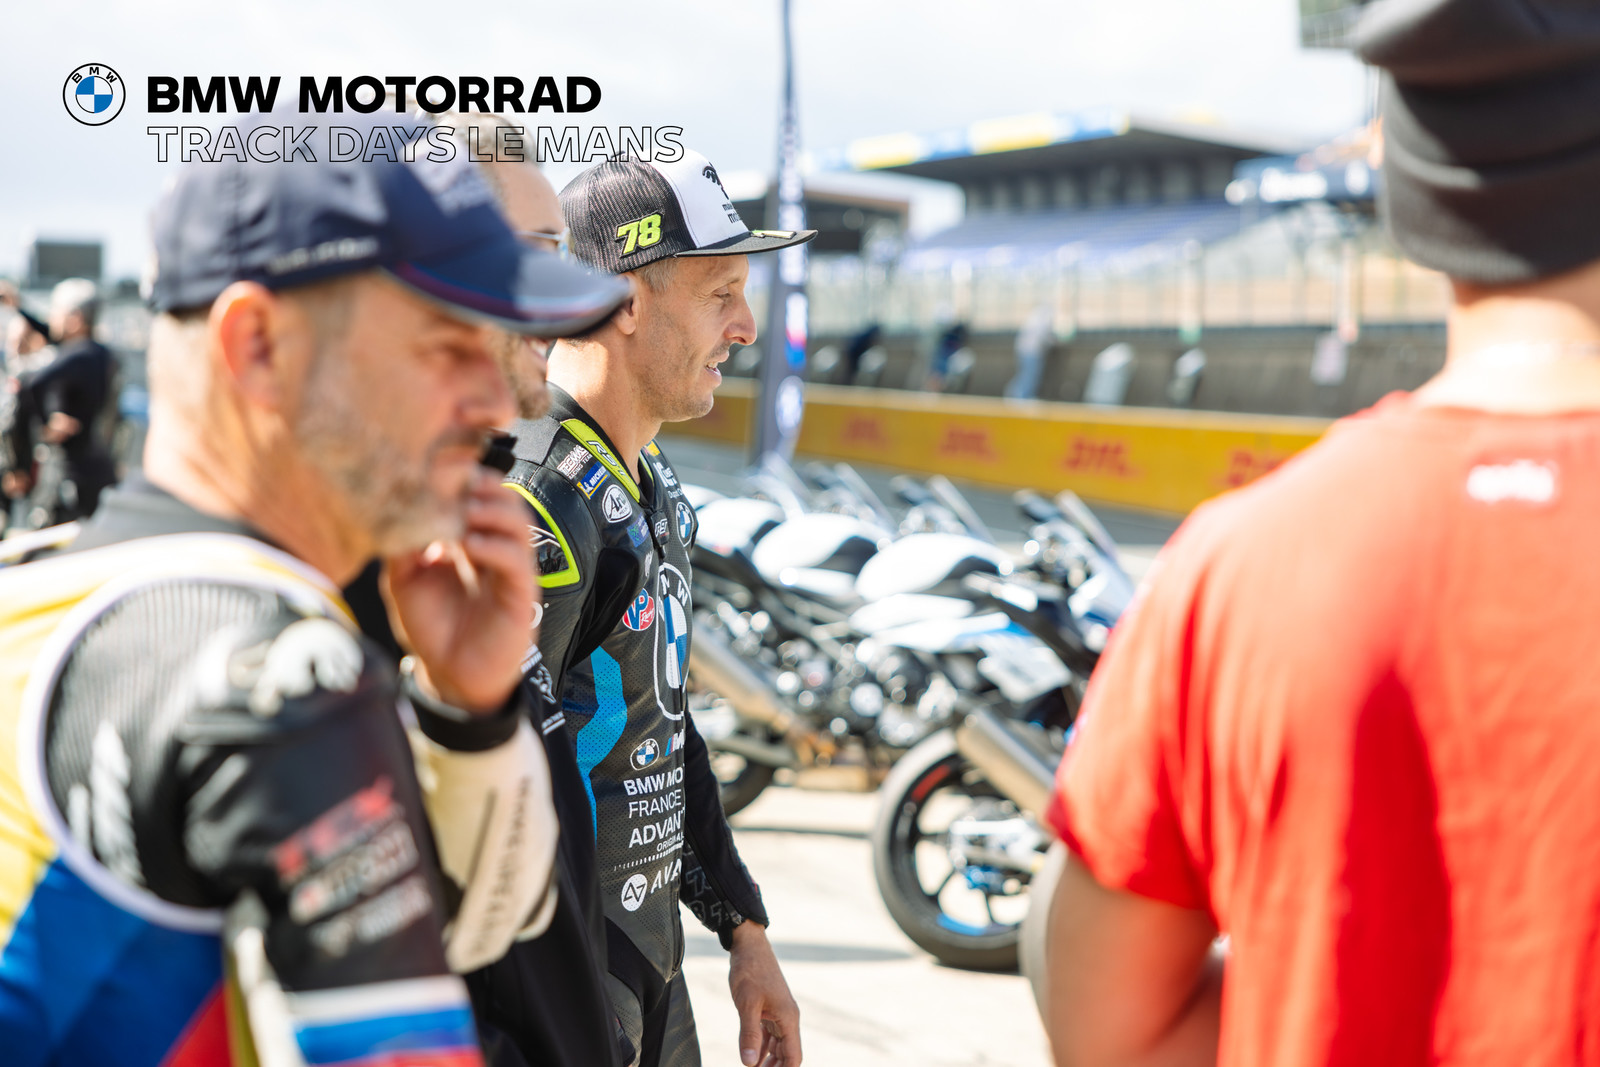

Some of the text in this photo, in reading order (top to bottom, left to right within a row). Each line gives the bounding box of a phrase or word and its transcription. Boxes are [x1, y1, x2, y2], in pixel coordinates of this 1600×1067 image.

[615, 212, 664, 258] 78
[626, 588, 649, 630] VP
[623, 765, 685, 796] BMW MO
[628, 789, 682, 819] FRANCE
